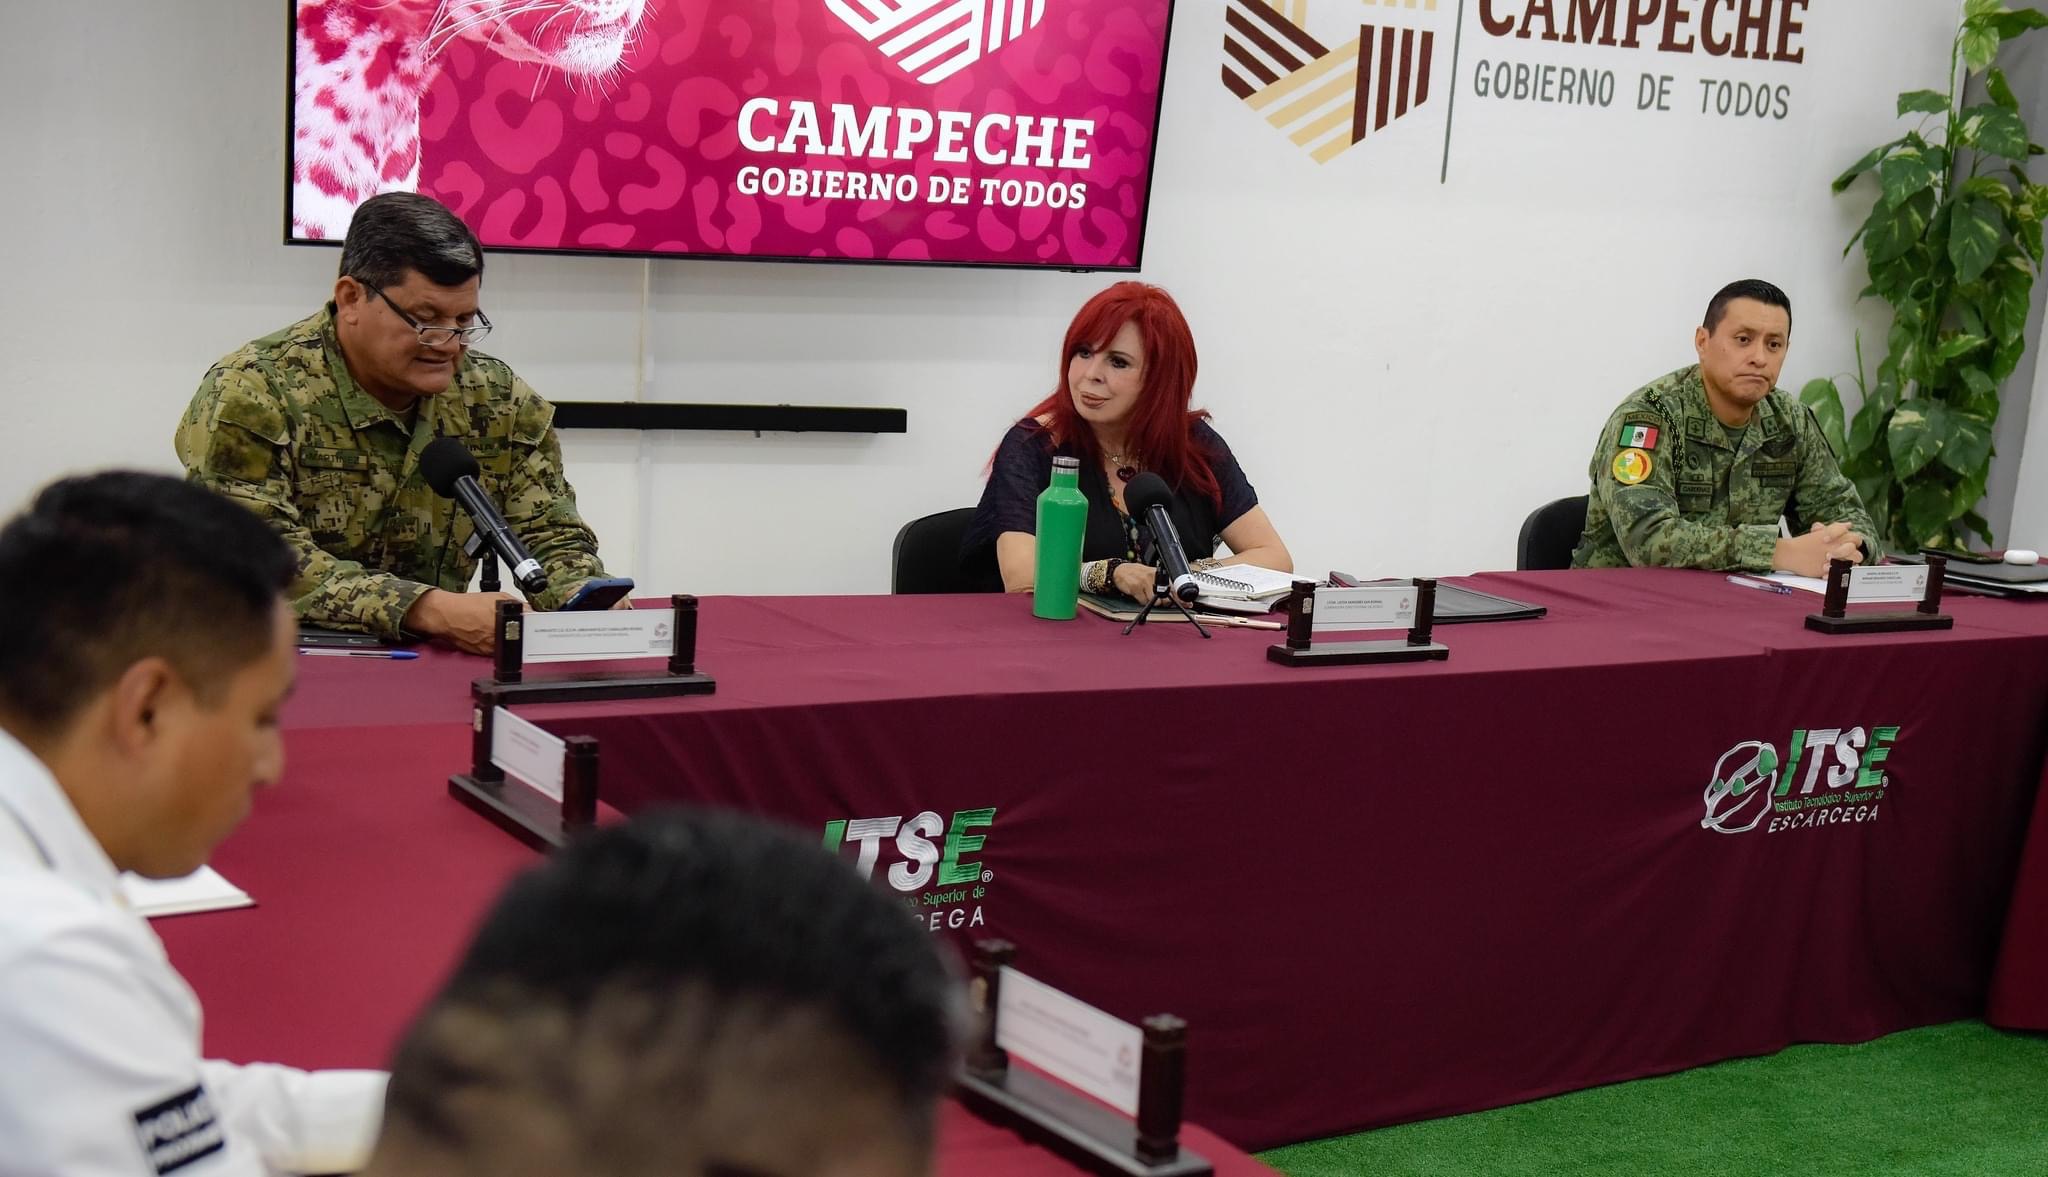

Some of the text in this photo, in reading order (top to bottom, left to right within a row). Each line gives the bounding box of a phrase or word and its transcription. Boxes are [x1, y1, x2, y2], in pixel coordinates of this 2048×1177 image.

[1478, 0, 1809, 64] CAMPECHE
[1474, 59, 1791, 120] GOBIERNO DE TODOS
[737, 97, 1095, 169] CAMPECHE
[737, 166, 1087, 209] GOBIERNO DE TODOS
[1774, 726, 1900, 796] ITSE
[1768, 805, 1879, 833] ESCÁRCEGA
[1774, 799, 1802, 812] Instituto
[1844, 790, 1874, 805] Superior
[1875, 789, 1884, 799] de
[923, 889, 967, 908] Superior
[972, 885, 985, 899] de
